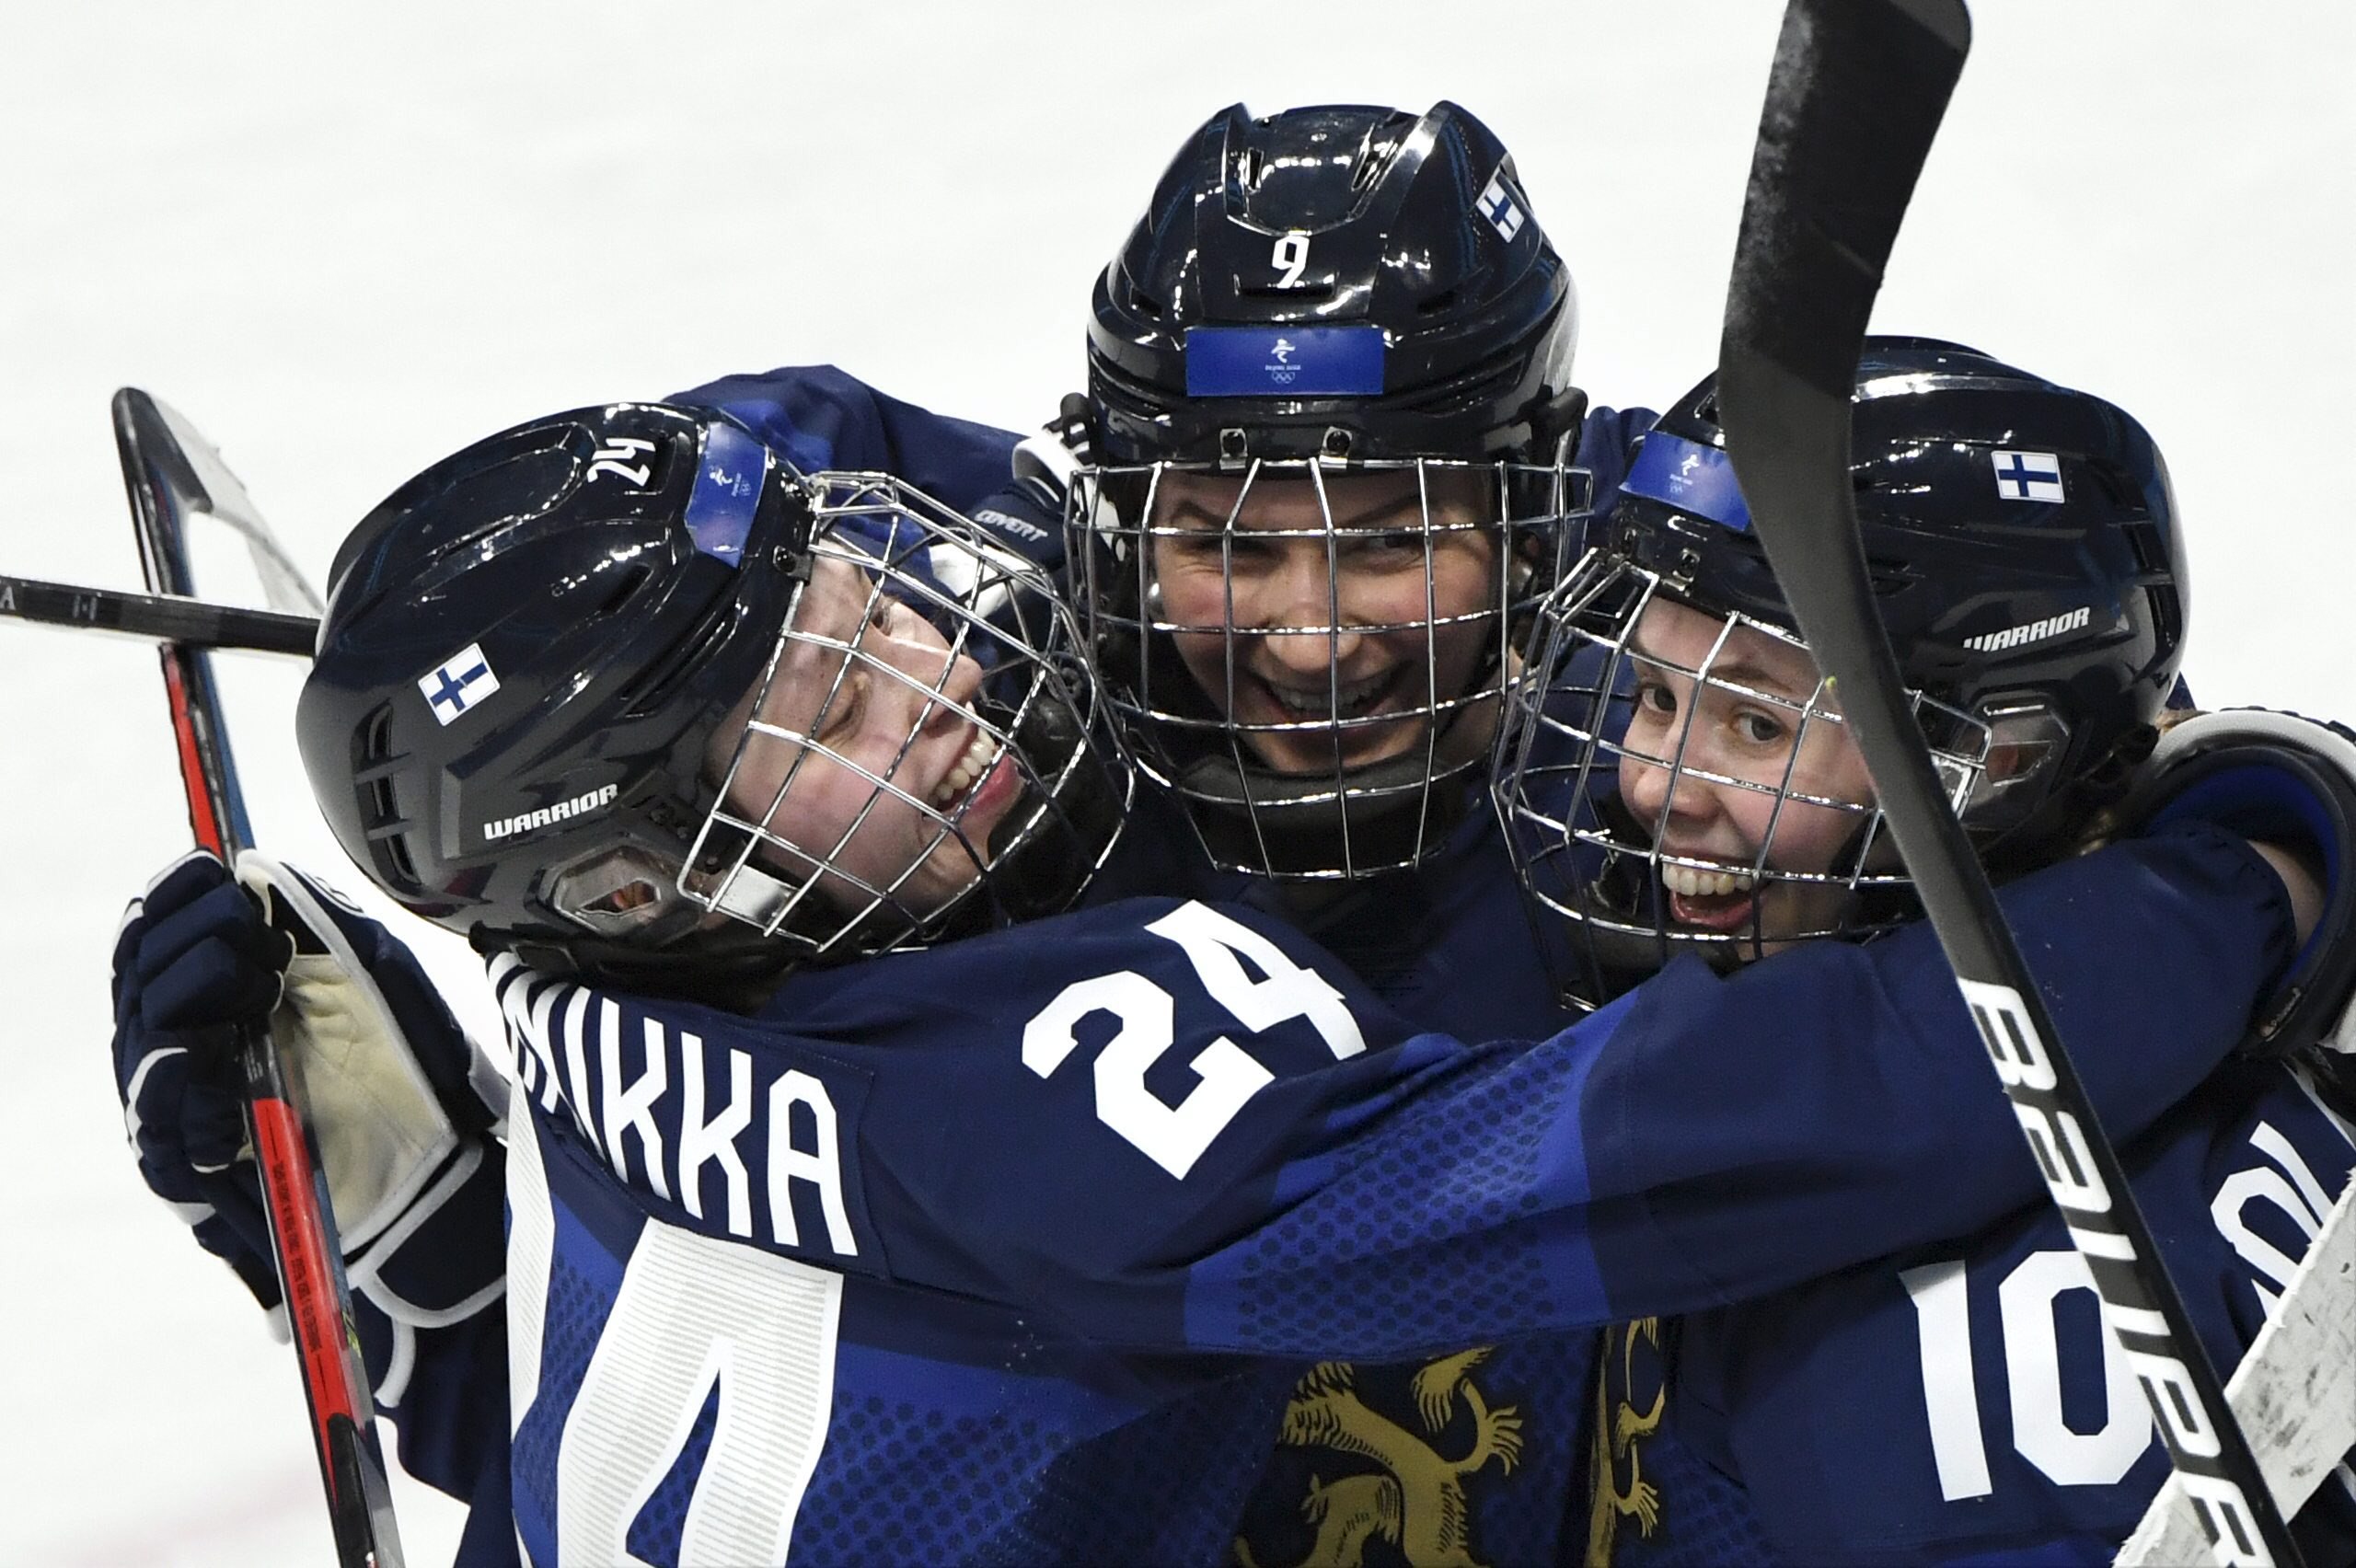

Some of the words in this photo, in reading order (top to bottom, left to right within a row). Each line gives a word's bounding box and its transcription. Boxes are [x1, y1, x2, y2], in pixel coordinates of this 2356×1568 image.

[1272, 236, 1310, 288] 9
[586, 438, 655, 487] 24
[974, 509, 1048, 542] COVERT
[1963, 606, 2090, 651] WARRIOR
[483, 784, 618, 840] WARRIOR
[1022, 899, 1367, 1182] 24
[1898, 1251, 2154, 1502] 10
